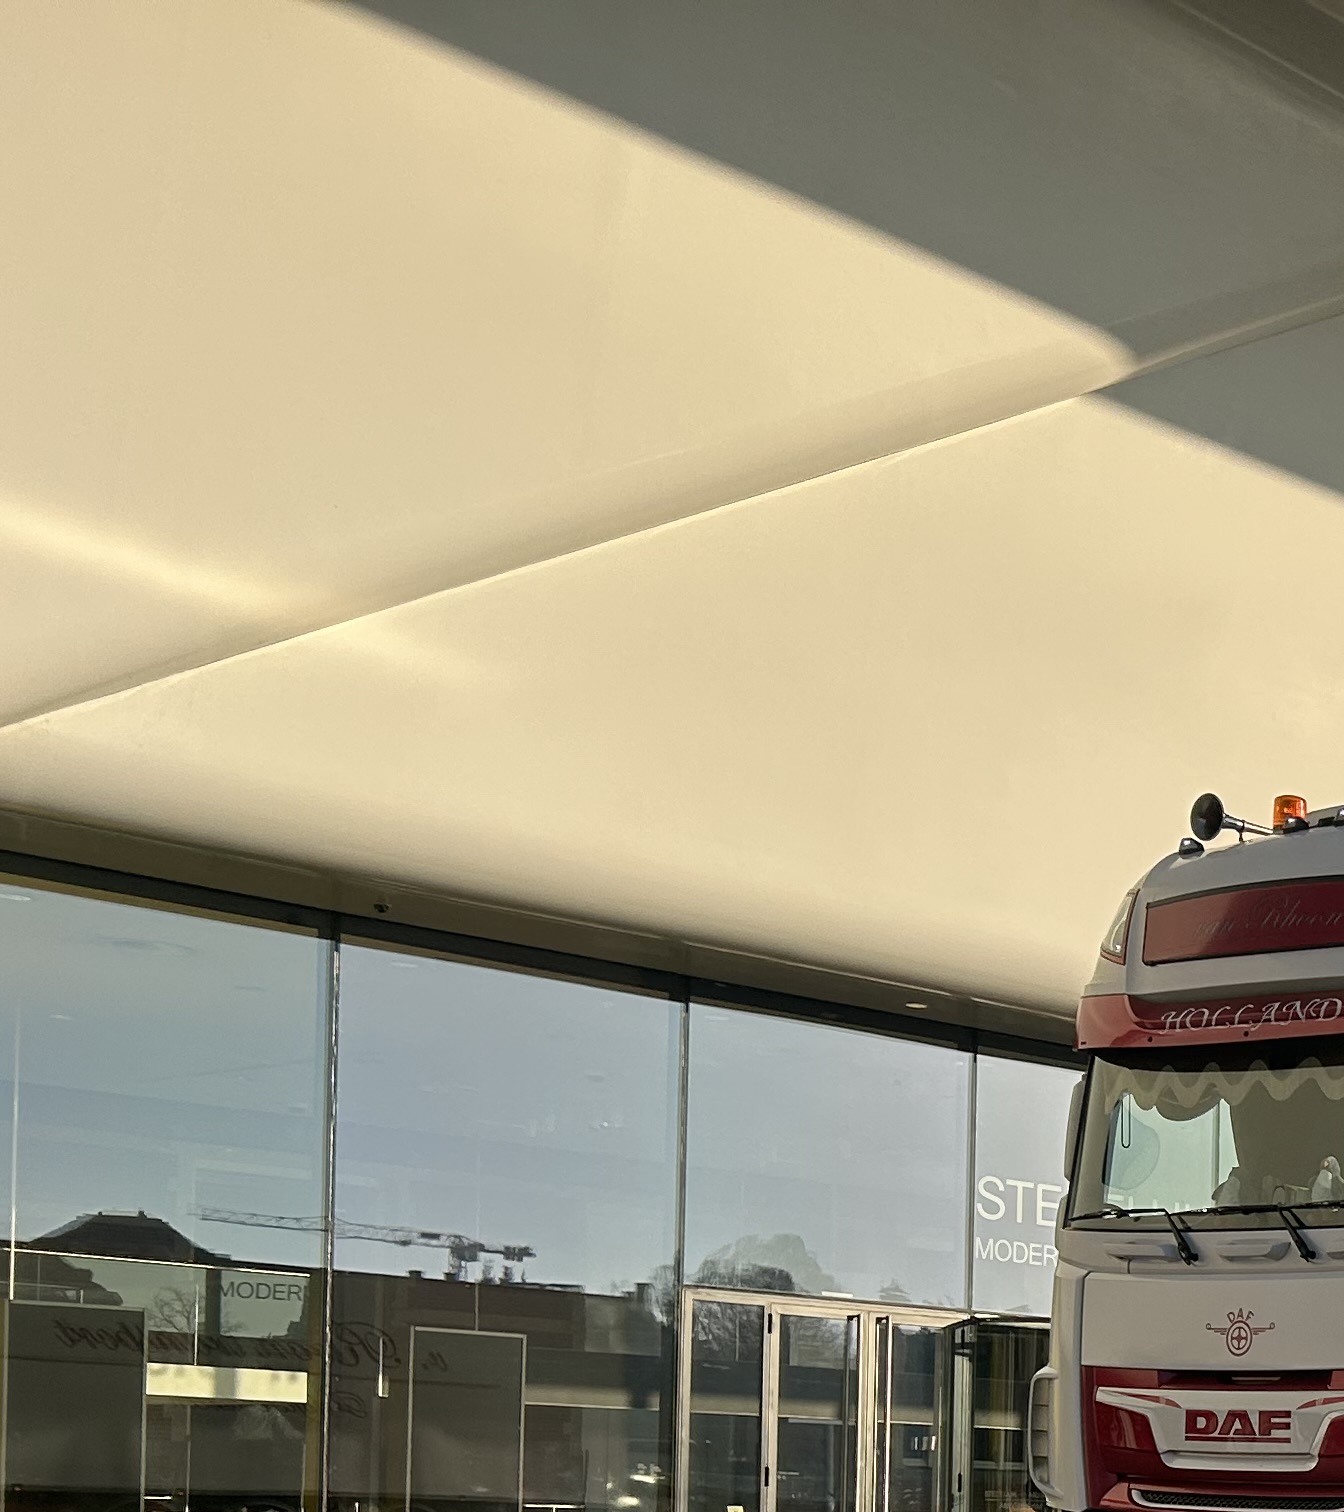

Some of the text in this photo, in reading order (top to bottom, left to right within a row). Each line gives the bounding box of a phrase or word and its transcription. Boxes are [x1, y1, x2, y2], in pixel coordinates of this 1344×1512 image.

[1158, 997, 1343, 1035] HOLLAND
[976, 1175, 1062, 1227] STE
[975, 1236, 1059, 1267] MODER
[1227, 1307, 1255, 1324] DAF
[1184, 1409, 1292, 1437] DAF
